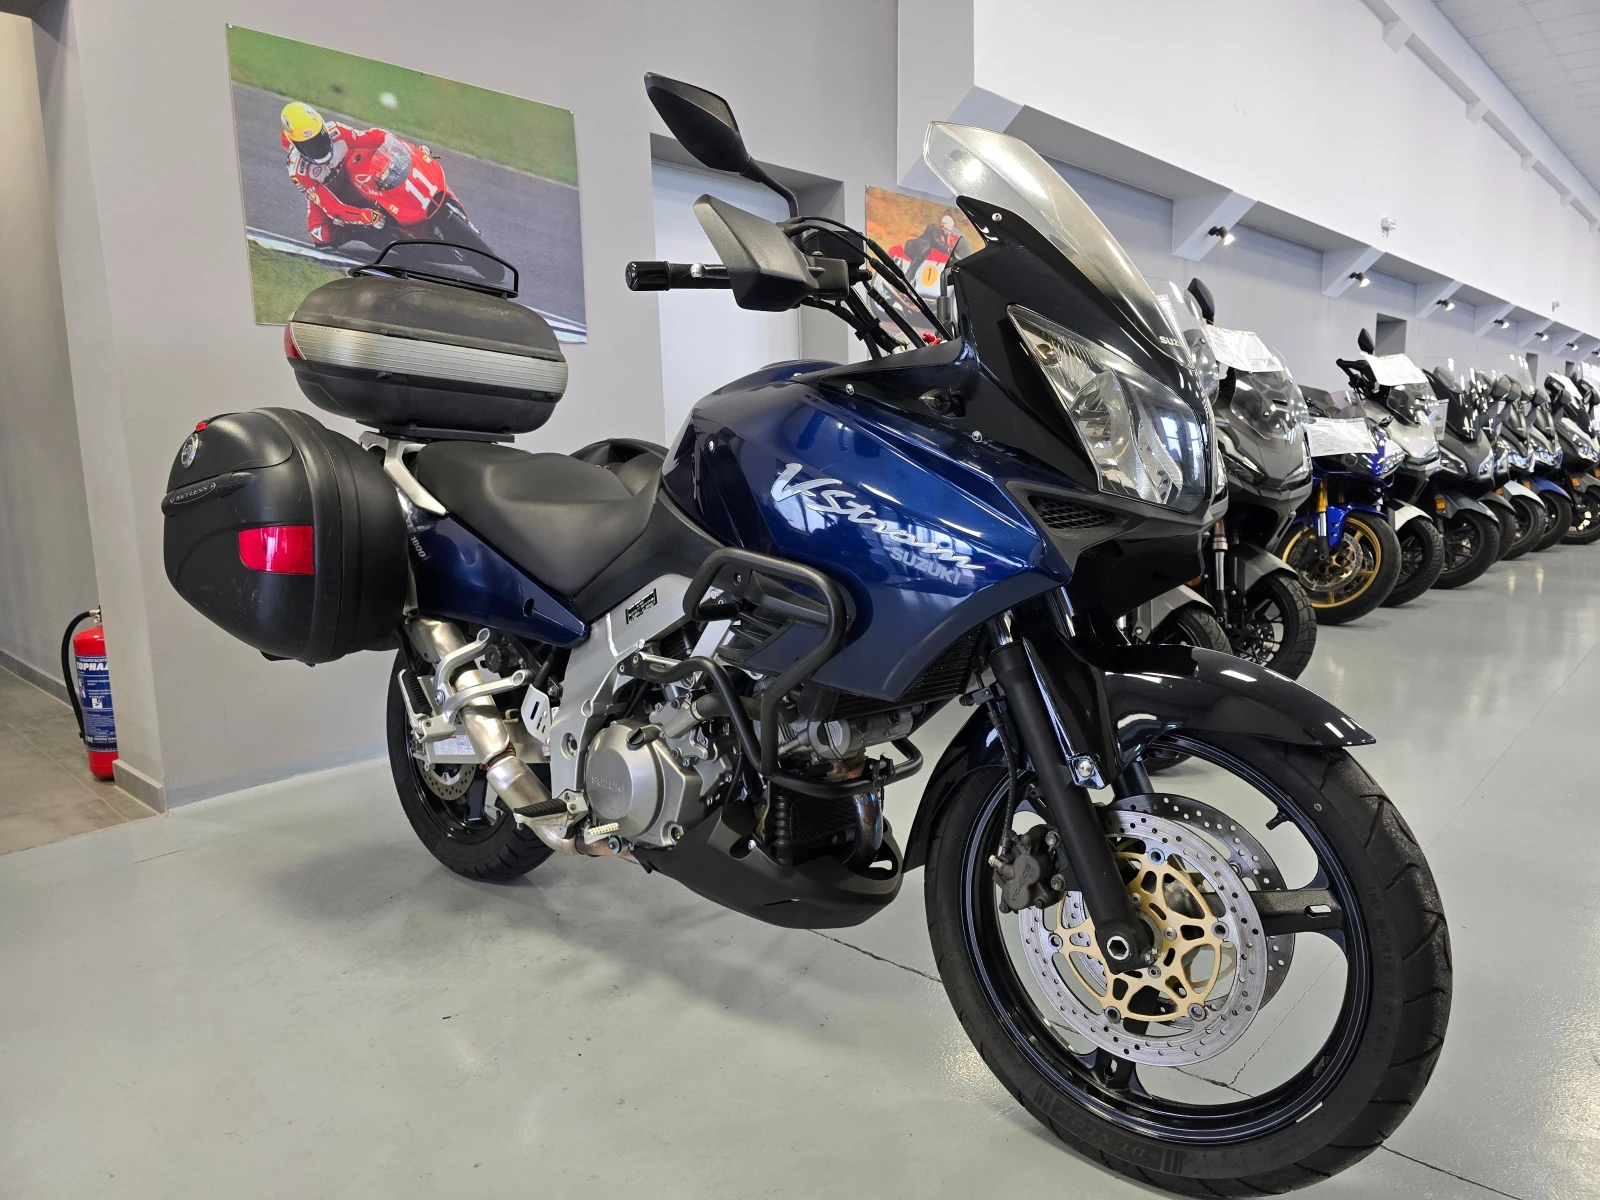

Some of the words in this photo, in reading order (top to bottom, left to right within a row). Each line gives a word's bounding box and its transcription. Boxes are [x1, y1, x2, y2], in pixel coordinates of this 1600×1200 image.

[405, 167, 438, 210] 11
[889, 547, 961, 585] SUZUKI
[591, 776, 625, 794] SUZUKI
[1056, 1107, 1149, 1158] DUNLOP
